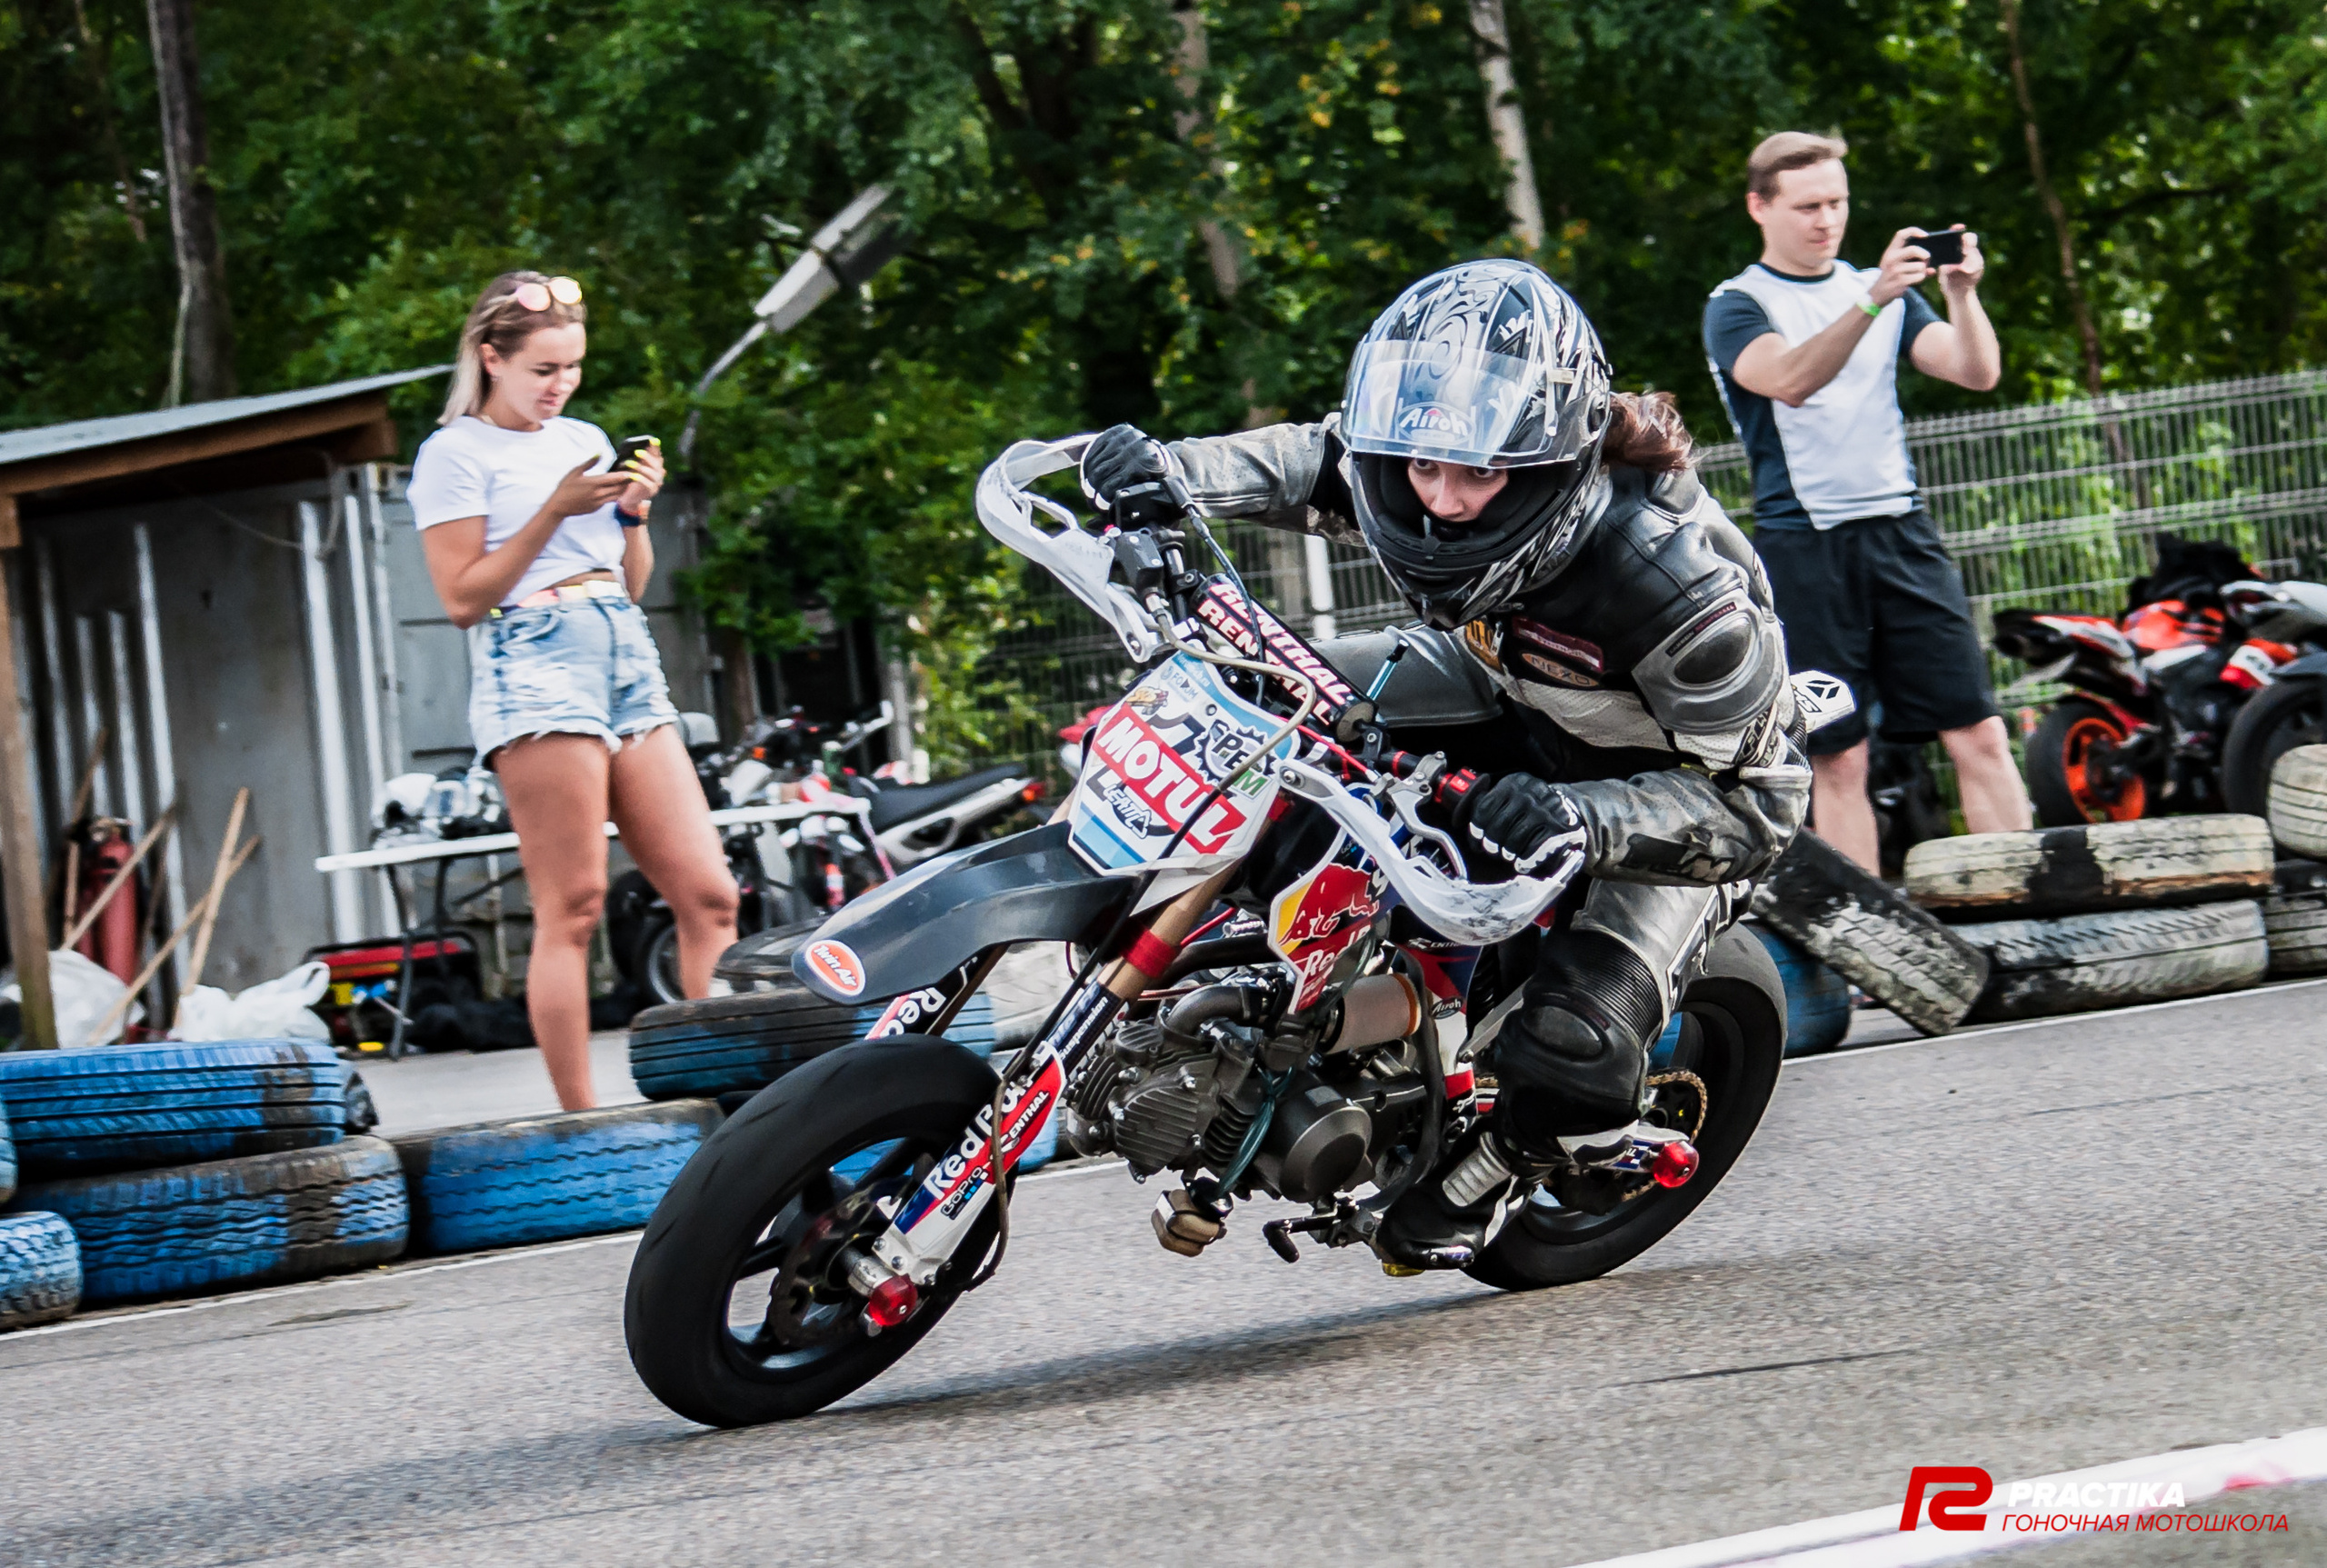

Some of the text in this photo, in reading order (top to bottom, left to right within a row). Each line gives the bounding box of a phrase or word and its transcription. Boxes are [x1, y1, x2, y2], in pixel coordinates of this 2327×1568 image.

[1399, 407, 1468, 436] Airoh
[1209, 584, 1353, 705] RENTHAL
[1531, 654, 1590, 685] NEXO
[1097, 716, 1236, 847] MOTUL
[814, 944, 857, 987] Twin Air
[1058, 996, 1109, 1060] Suspension
[924, 1125, 985, 1200] Red
[942, 1165, 984, 1216] GoPro
